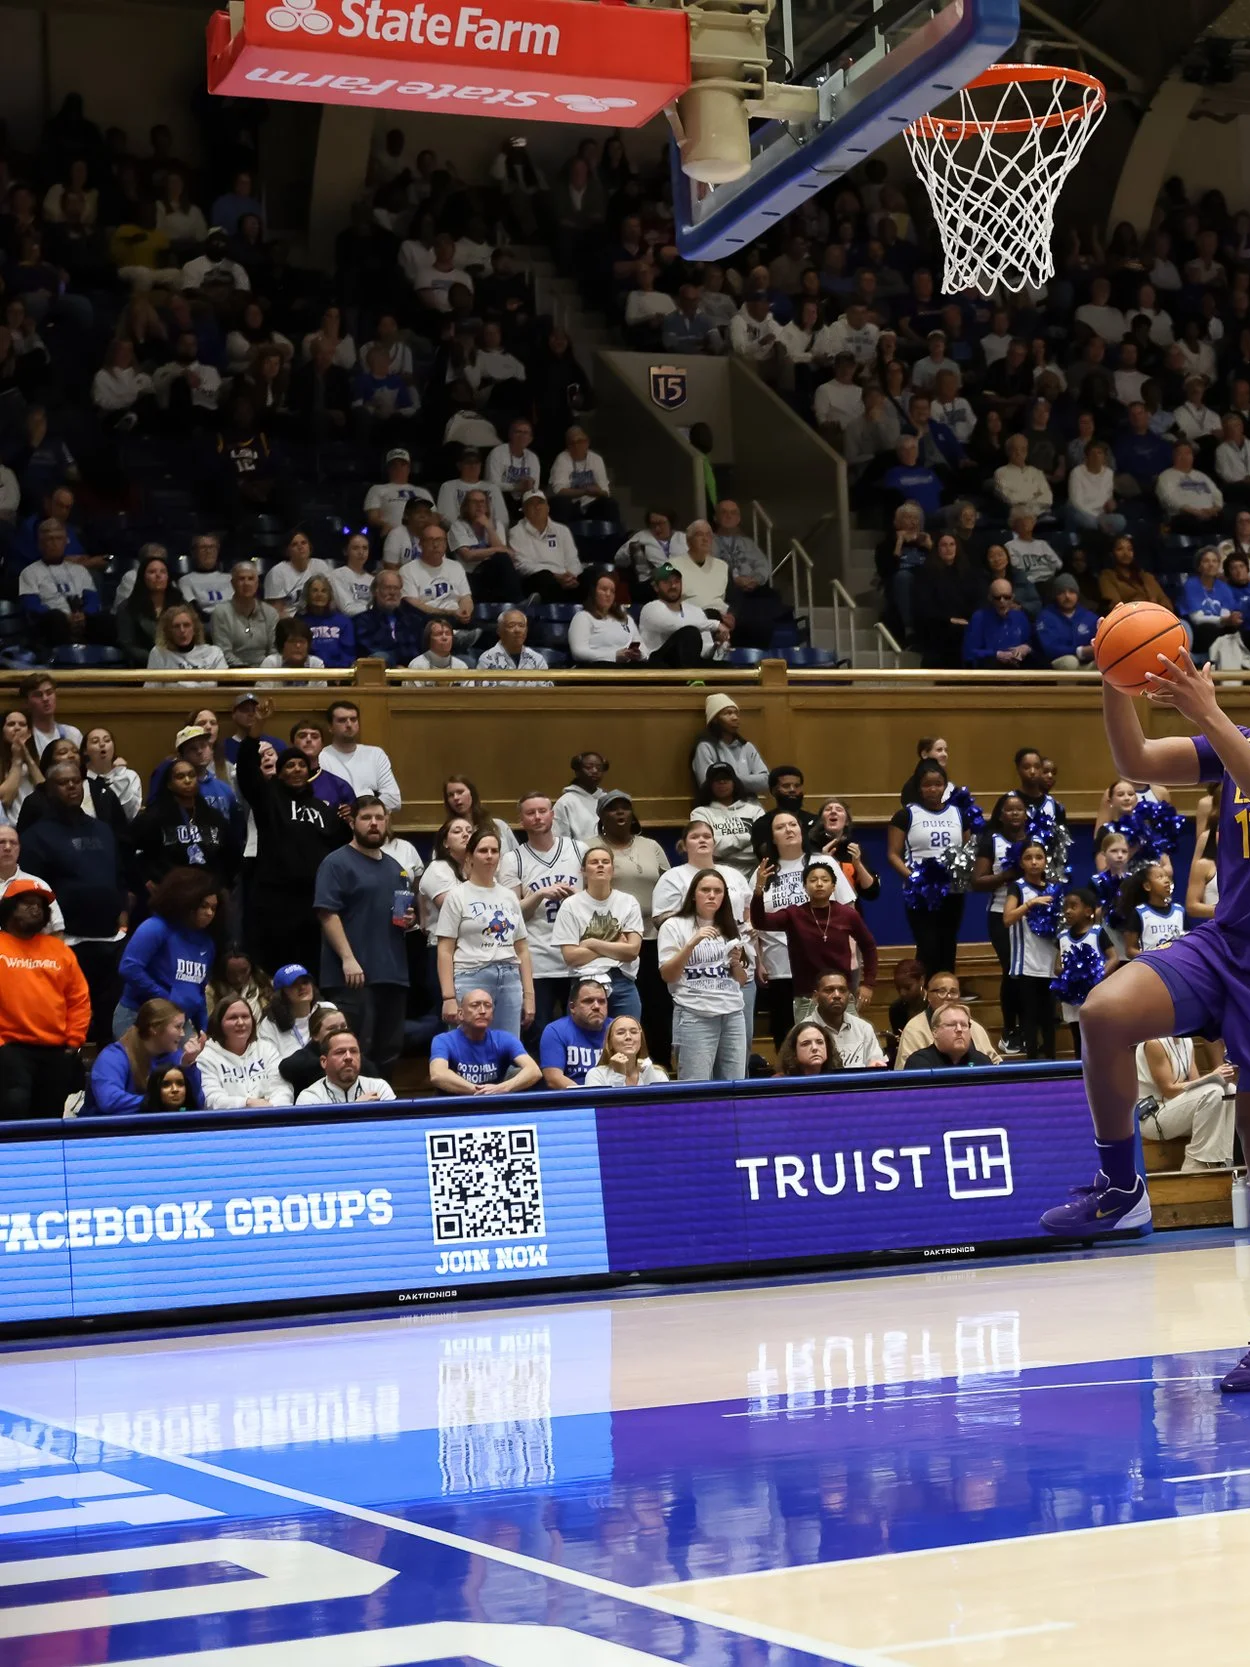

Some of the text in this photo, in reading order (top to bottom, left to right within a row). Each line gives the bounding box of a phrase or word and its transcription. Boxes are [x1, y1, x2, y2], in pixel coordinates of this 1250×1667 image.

[657, 376, 684, 401] 15
[921, 820, 953, 829] DUKE
[929, 832, 949, 847] 26
[457, 1063, 497, 1073] GO TO HELL
[736, 1147, 931, 1200] TRUIST
[225, 1188, 393, 1235] GROUPS
[436, 1243, 548, 1274] JOIN NOW
[924, 1246, 975, 1256] DAKTRONICS
[398, 1290, 457, 1301] DAKTRONICS
